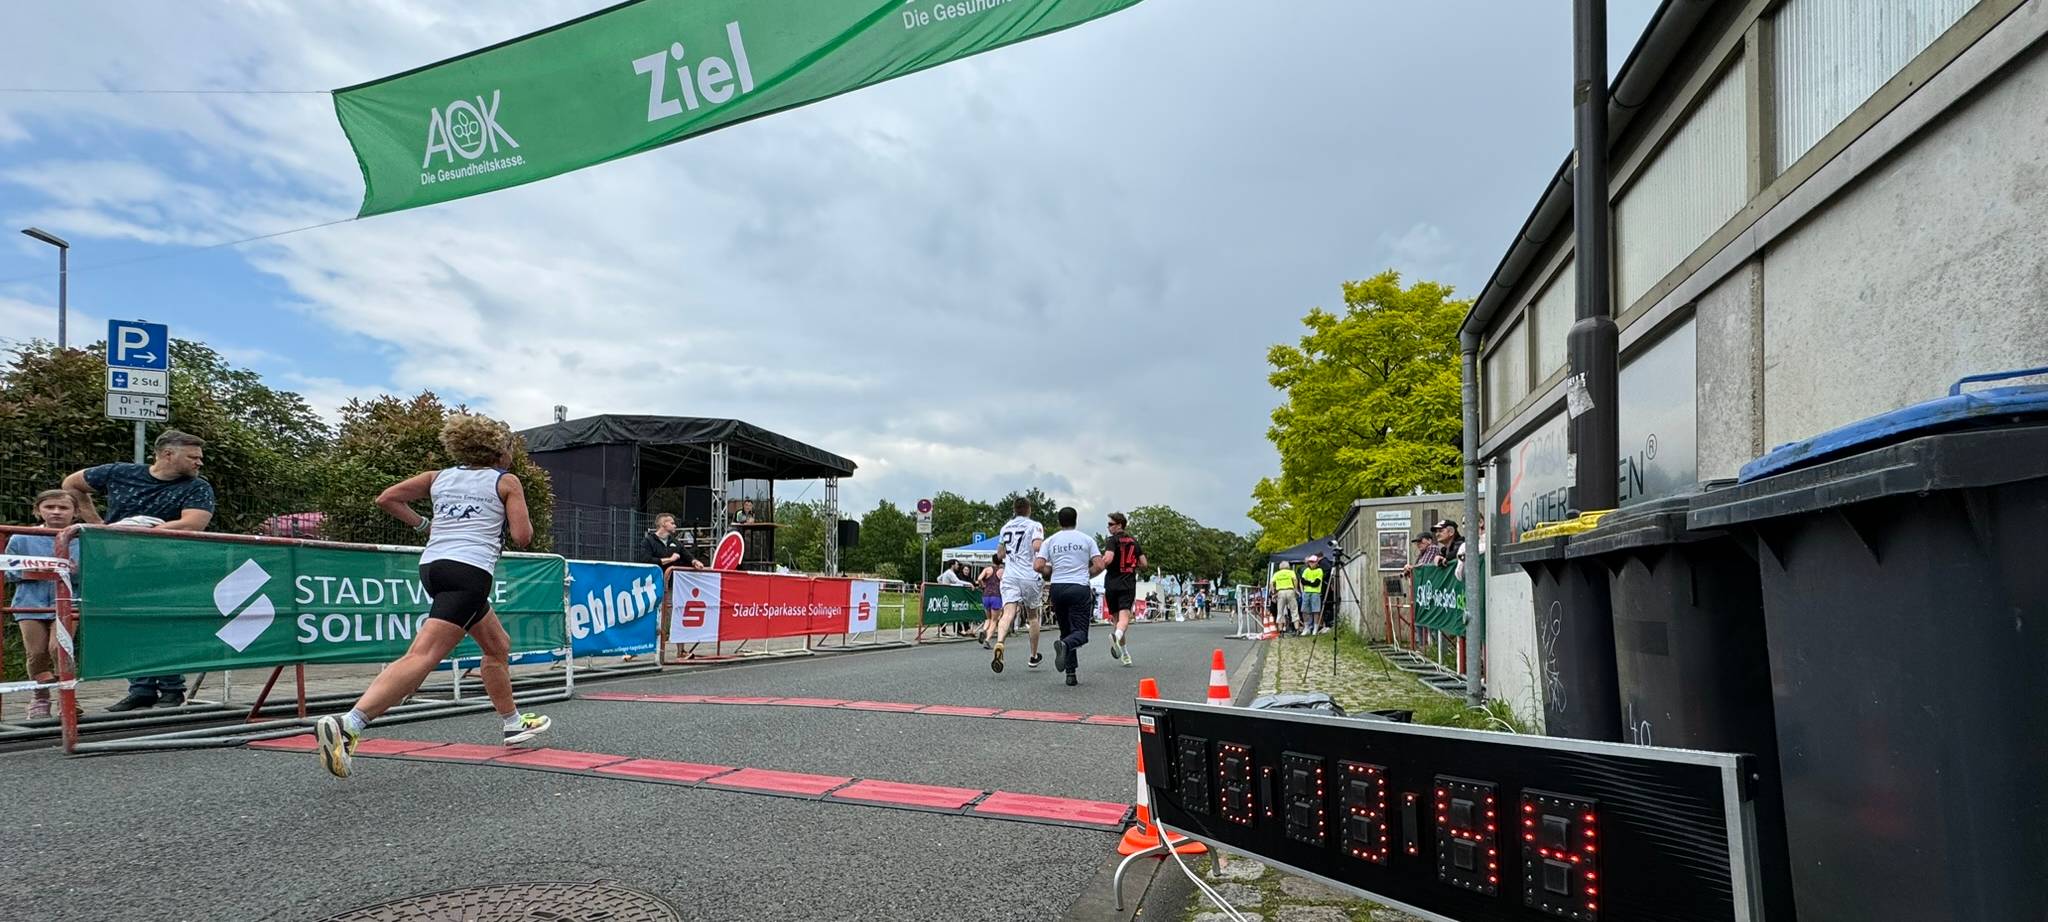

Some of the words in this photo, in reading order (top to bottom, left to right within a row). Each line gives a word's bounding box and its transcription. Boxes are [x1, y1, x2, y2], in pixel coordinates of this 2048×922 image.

[903, 9, 930, 29] Die
[632, 20, 754, 122] Ziel
[423, 89, 520, 169] AOK
[421, 172, 436, 185] Die
[437, 155, 526, 182] Gesundheitskasse.
[118, 326, 150, 361] P
[132, 377, 139, 386] 2
[119, 407, 127, 415] 11
[139, 408, 156, 417] 17h
[121, 396, 131, 404] Di
[143, 397, 155, 406] Fr
[975, 534, 985, 544] P
[1003, 531, 1025, 555] 27
[1120, 544, 1137, 568] 14
[295, 575, 507, 605] STADTWE
[732, 602, 807, 619] Stadt-Sparkasse
[808, 603, 842, 618] Solingen
[927, 597, 942, 612] AOK
